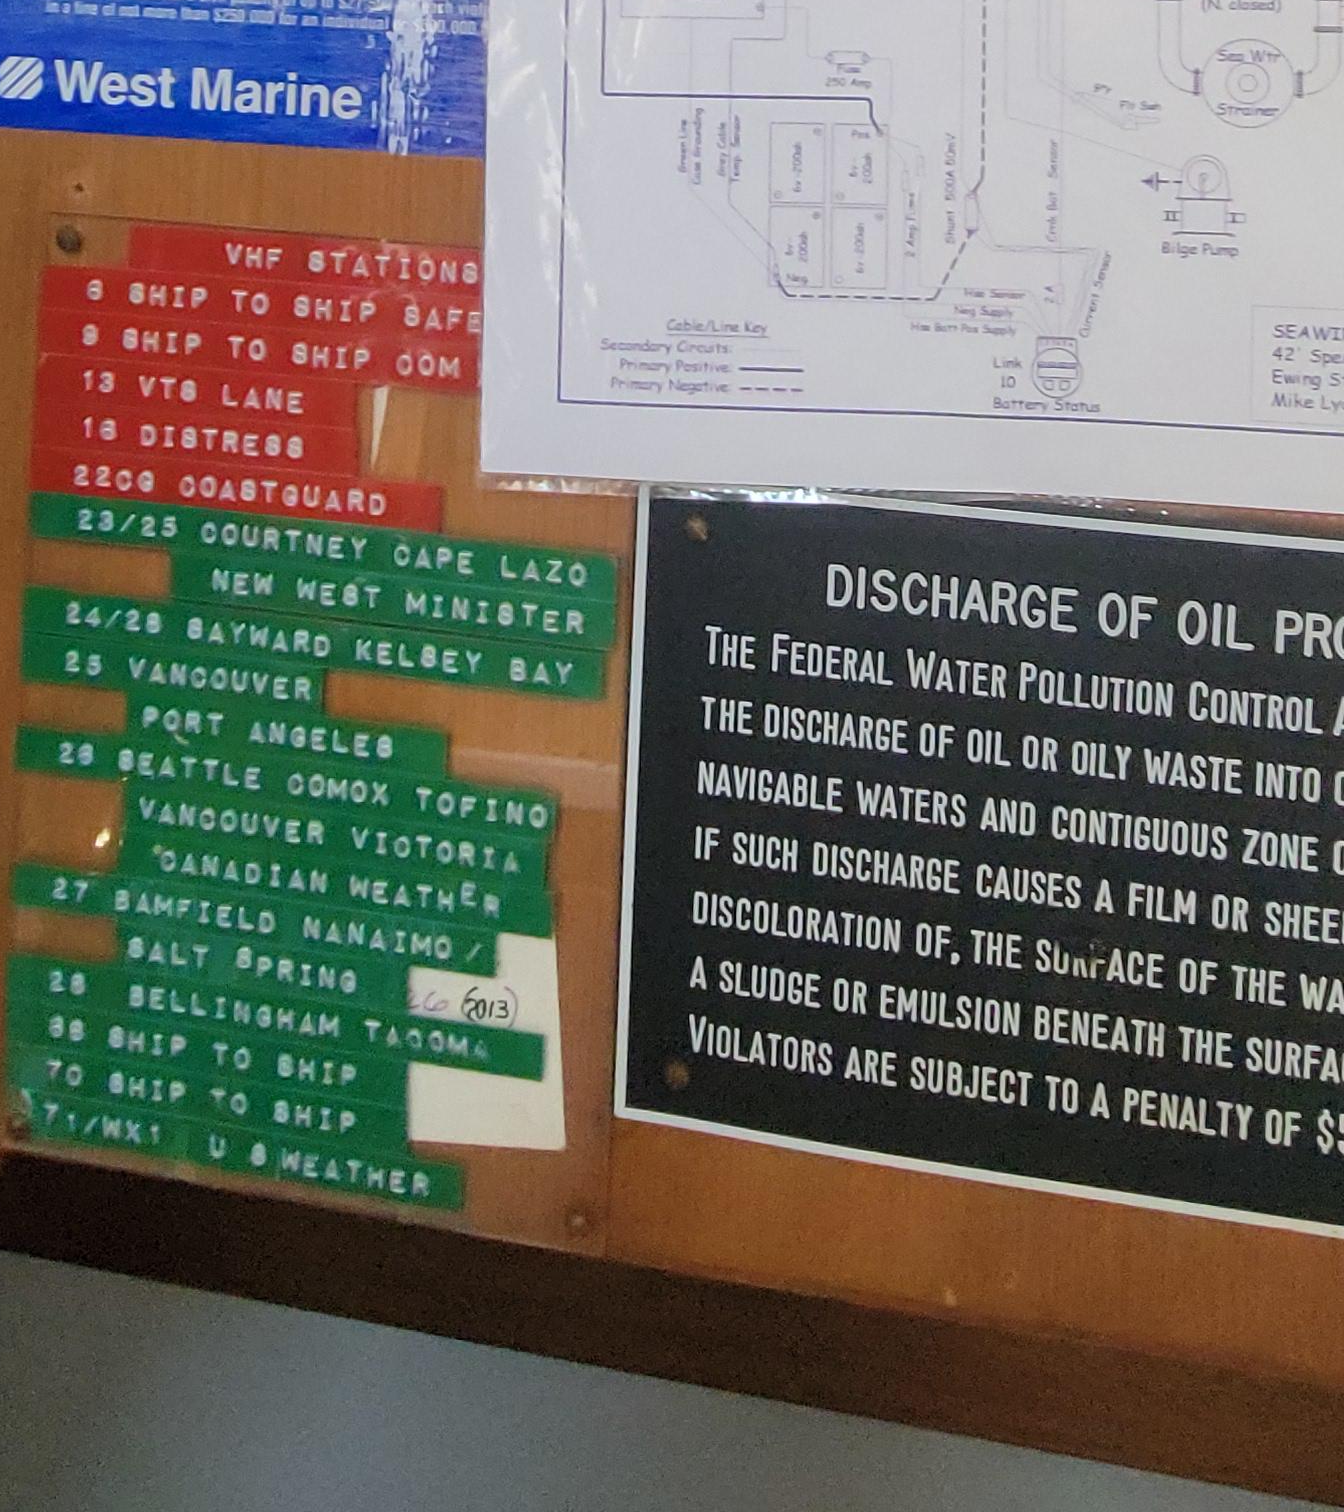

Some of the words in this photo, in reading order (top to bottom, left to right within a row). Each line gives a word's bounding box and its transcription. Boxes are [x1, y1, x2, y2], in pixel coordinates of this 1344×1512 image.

[54, 59, 176, 110] West
[191, 67, 363, 120] Marine
[224, 242, 283, 271] VHF
[307, 250, 480, 285] STATIONS
[1161, 241, 1198, 258] Bilge
[1203, 243, 1239, 259] Pump
[122, 327, 202, 356] SHIP
[228, 335, 267, 362] TO
[291, 342, 371, 371] SHIP
[396, 351, 461, 379] COM
[600, 338, 671, 355] Secondary
[993, 356, 1023, 370] Link
[82, 370, 115, 394] 13
[138, 375, 197, 403] VTS
[222, 384, 304, 414] LANE
[1271, 369, 1322, 390] Ewing
[1271, 392, 1314, 410] Mike
[993, 396, 1049, 412] Battery
[1054, 398, 1101, 413] Status
[140, 424, 304, 459] DISTRESS
[179, 475, 387, 517] COASTGUARD
[212, 568, 274, 597] NEW
[297, 578, 382, 610] WEST
[405, 594, 585, 635] MINISTER
[826, 563, 1079, 634] DISCHARGE
[1097, 592, 1158, 639] OF
[1177, 599, 1255, 652] OIL
[64, 650, 102, 676] 25
[128, 655, 312, 700] VANCOUVER
[142, 706, 224, 737] PORT
[248, 720, 394, 759] ANGELES
[158, 848, 329, 895] CANADIAN
[348, 874, 502, 920] WEATHER
[127, 936, 210, 969] SALT
[236, 947, 358, 994] SPRING
[460, 985, 519, 1028] (2013)
[689, 1013, 833, 1076] VIOLATORS
[844, 1045, 897, 1087] ARE
[910, 1055, 1034, 1106] SUBJECT
[1045, 1074, 1078, 1115] TO
[1091, 1082, 1110, 1120] A
[1123, 1087, 1253, 1141] PENALTY
[1264, 1108, 1302, 1147] OF
